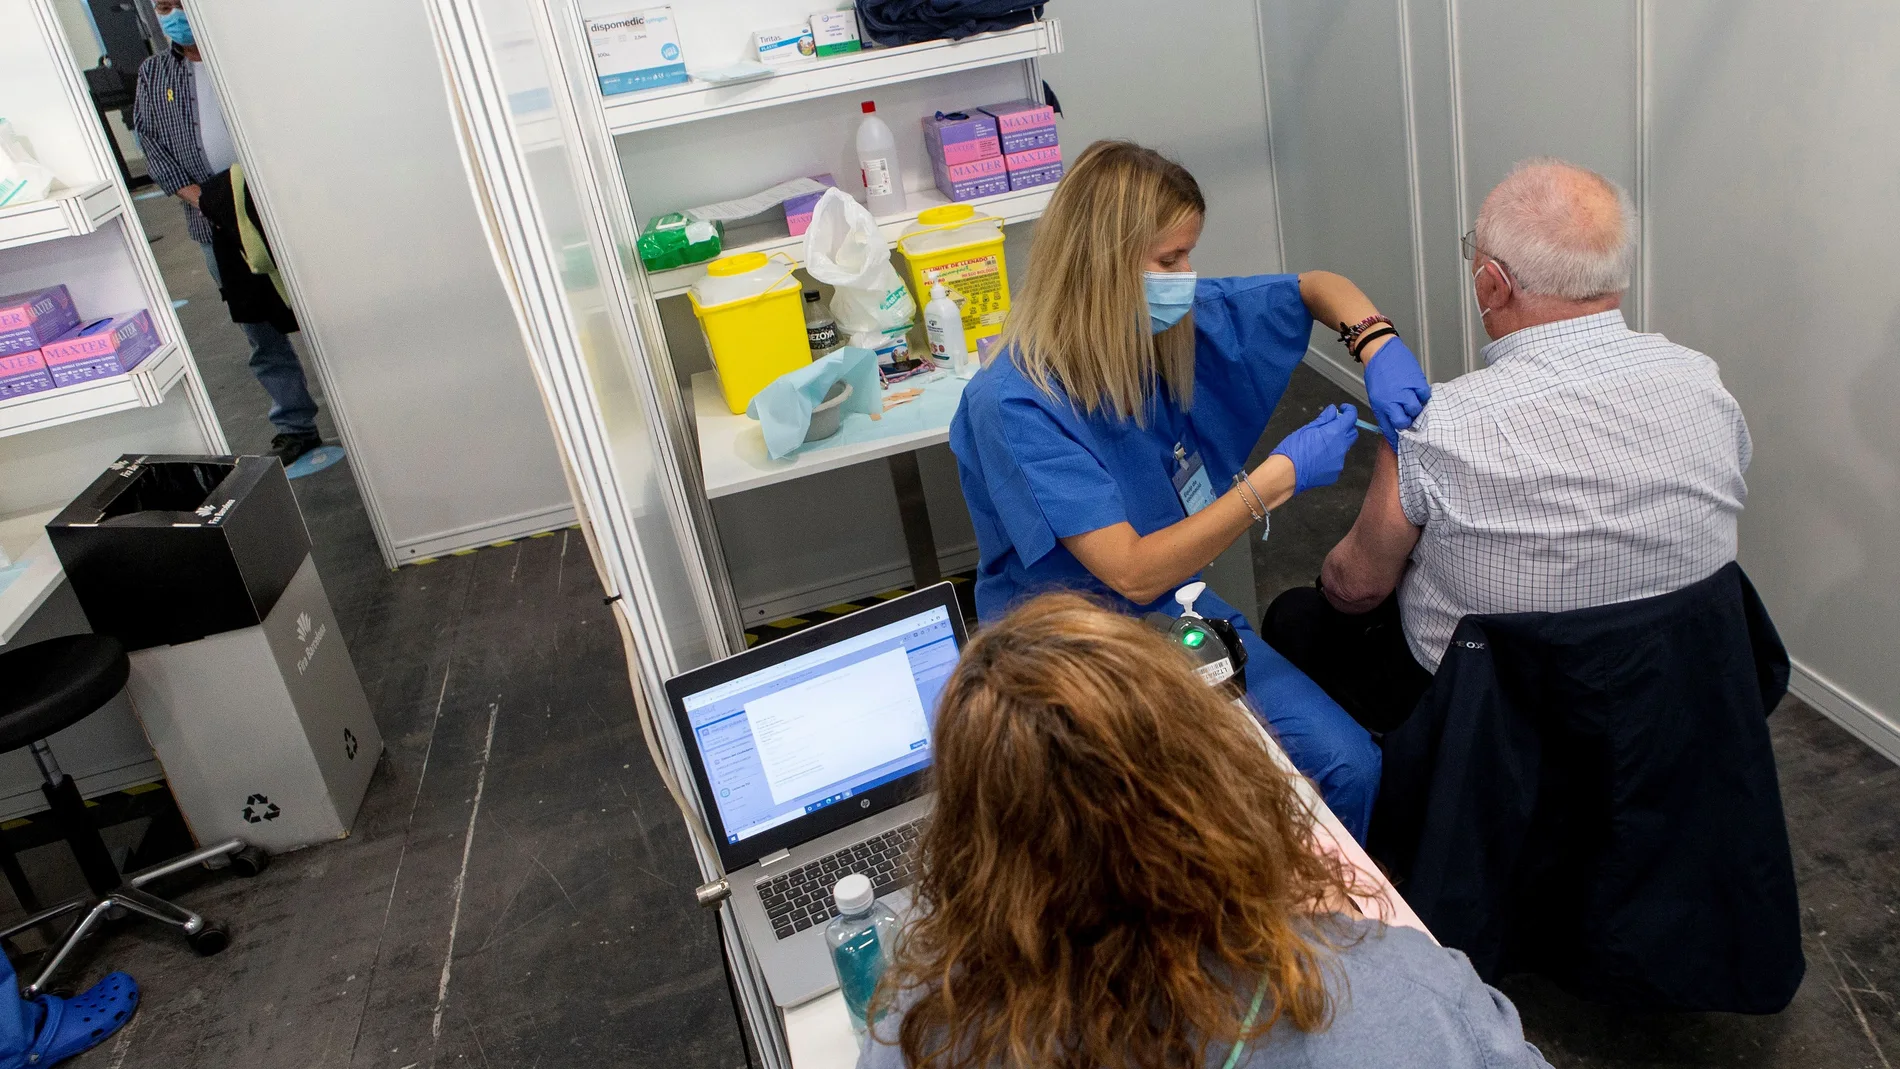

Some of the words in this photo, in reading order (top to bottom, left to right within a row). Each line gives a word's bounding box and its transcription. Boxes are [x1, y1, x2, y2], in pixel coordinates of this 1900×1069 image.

[591, 16, 644, 32] dispomedic
[1003, 110, 1051, 128] MAXTER
[1010, 148, 1057, 165] MAXTER
[954, 160, 1001, 177] MAXTER
[46, 338, 108, 359] MAXTER
